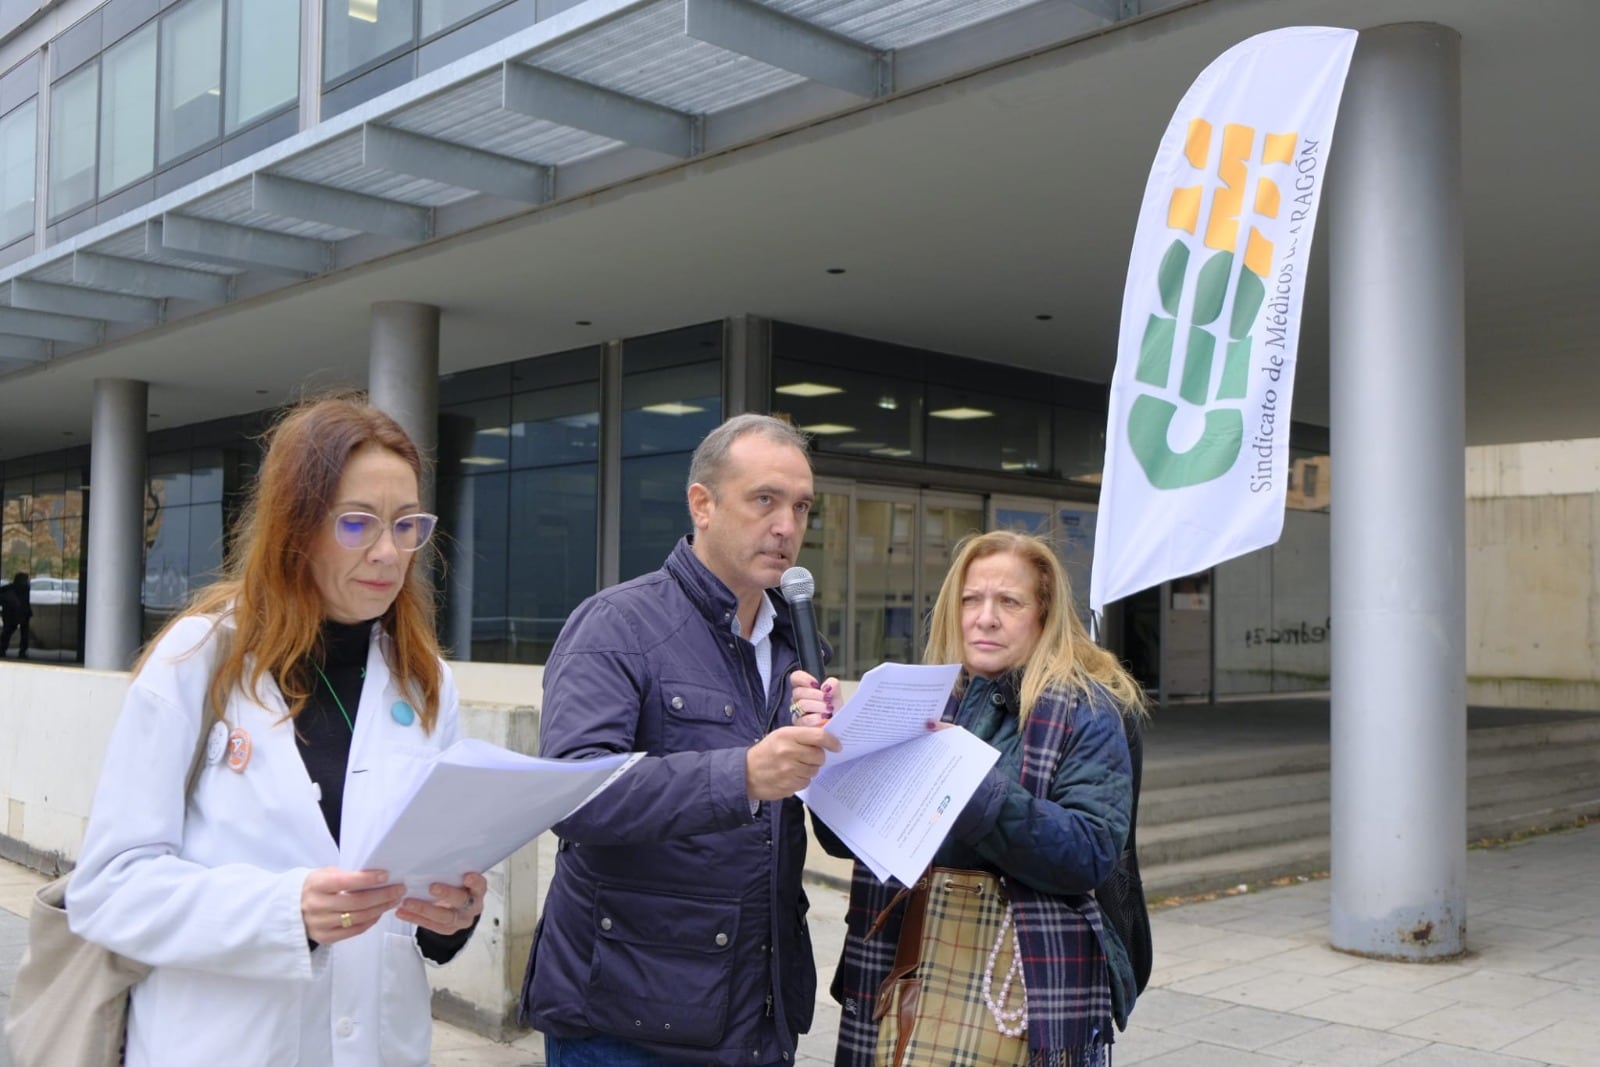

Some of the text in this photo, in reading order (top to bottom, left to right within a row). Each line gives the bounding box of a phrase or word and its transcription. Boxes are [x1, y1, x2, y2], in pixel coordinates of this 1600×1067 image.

[1265, 264, 1293, 349] Médicos
[1262, 355, 1284, 382] de
[1250, 389, 1277, 493] Sindicato
